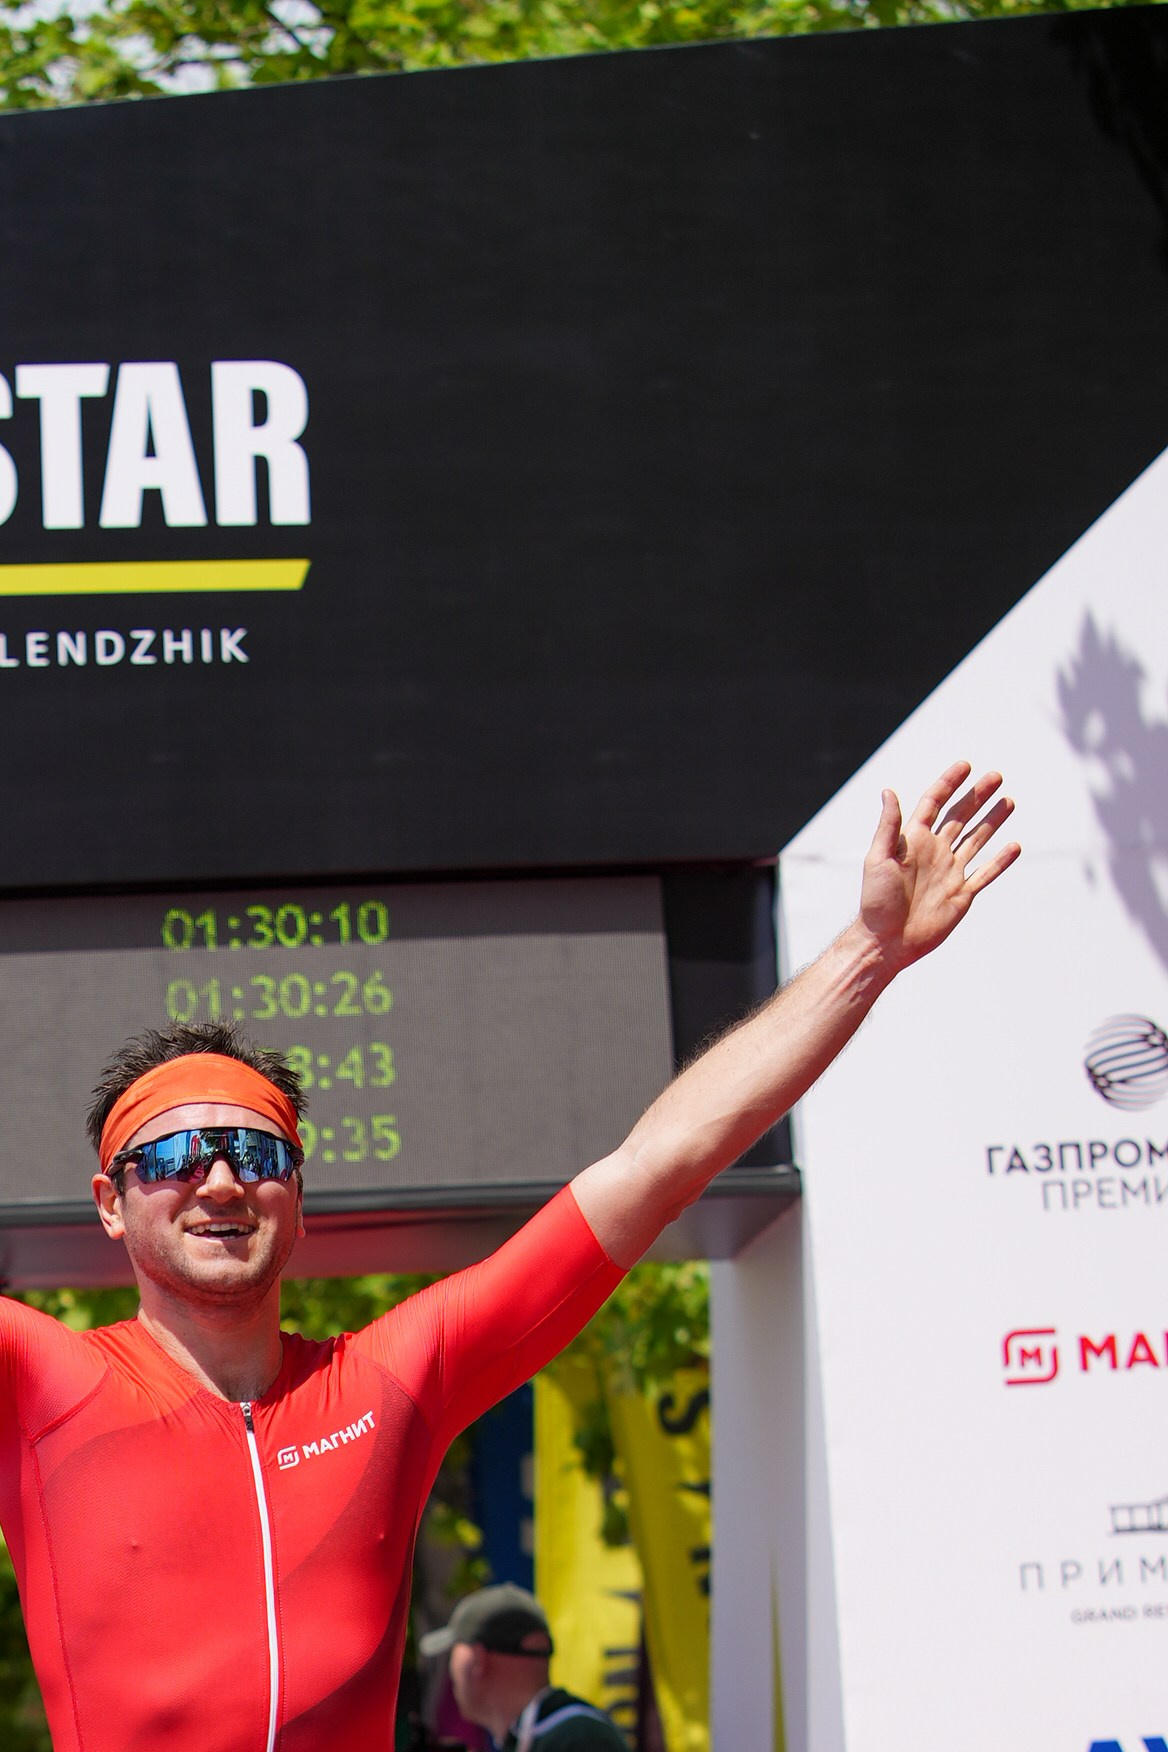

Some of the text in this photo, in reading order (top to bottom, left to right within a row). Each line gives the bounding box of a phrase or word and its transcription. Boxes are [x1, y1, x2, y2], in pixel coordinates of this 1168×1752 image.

[163, 900, 390, 951] 01:30:10
[167, 970, 394, 1023] 01:30:26
[1077, 1329, 1168, 1374] МА
[301, 1410, 376, 1459] МАГНИТ
